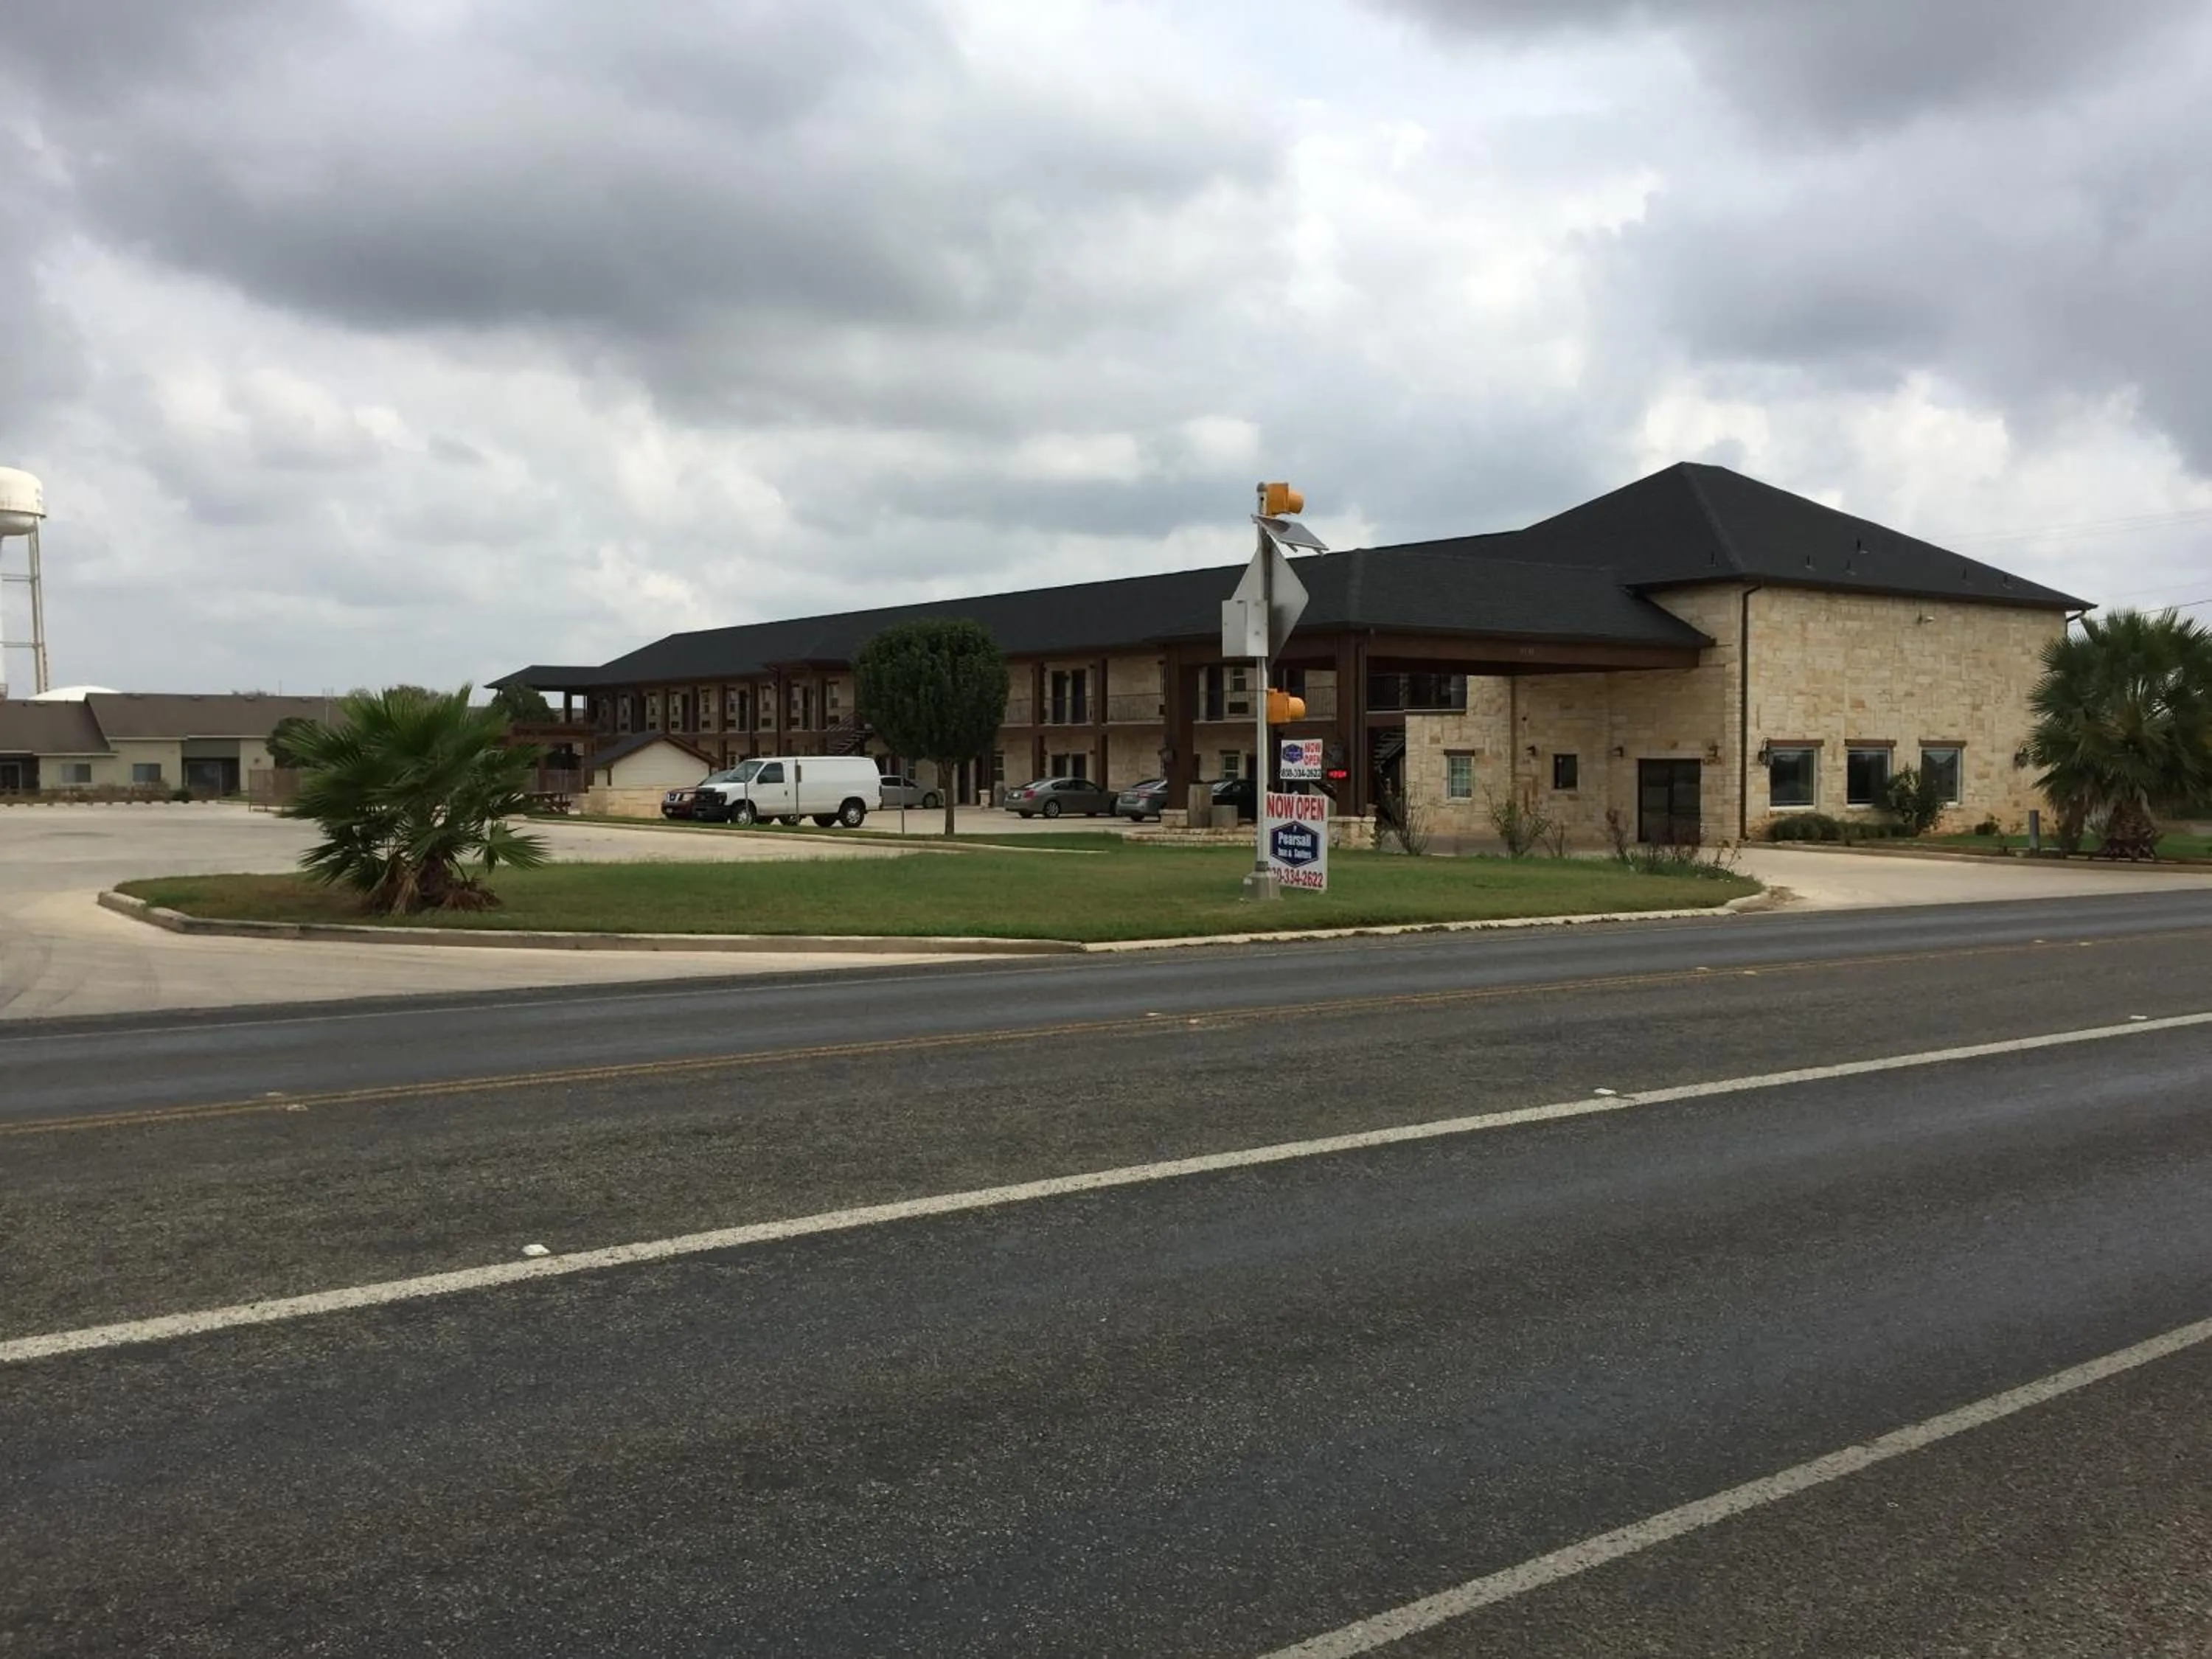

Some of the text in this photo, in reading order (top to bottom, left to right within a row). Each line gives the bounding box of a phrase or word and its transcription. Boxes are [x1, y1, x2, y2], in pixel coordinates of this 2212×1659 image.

[1304, 742, 1321, 752] NOW
[1304, 754, 1320, 765] OPEN
[1267, 794, 1324, 821] NOW OPEN
[1278, 832, 1312, 847] Pearsall
[1267, 867, 1324, 888] 0-334-2622
